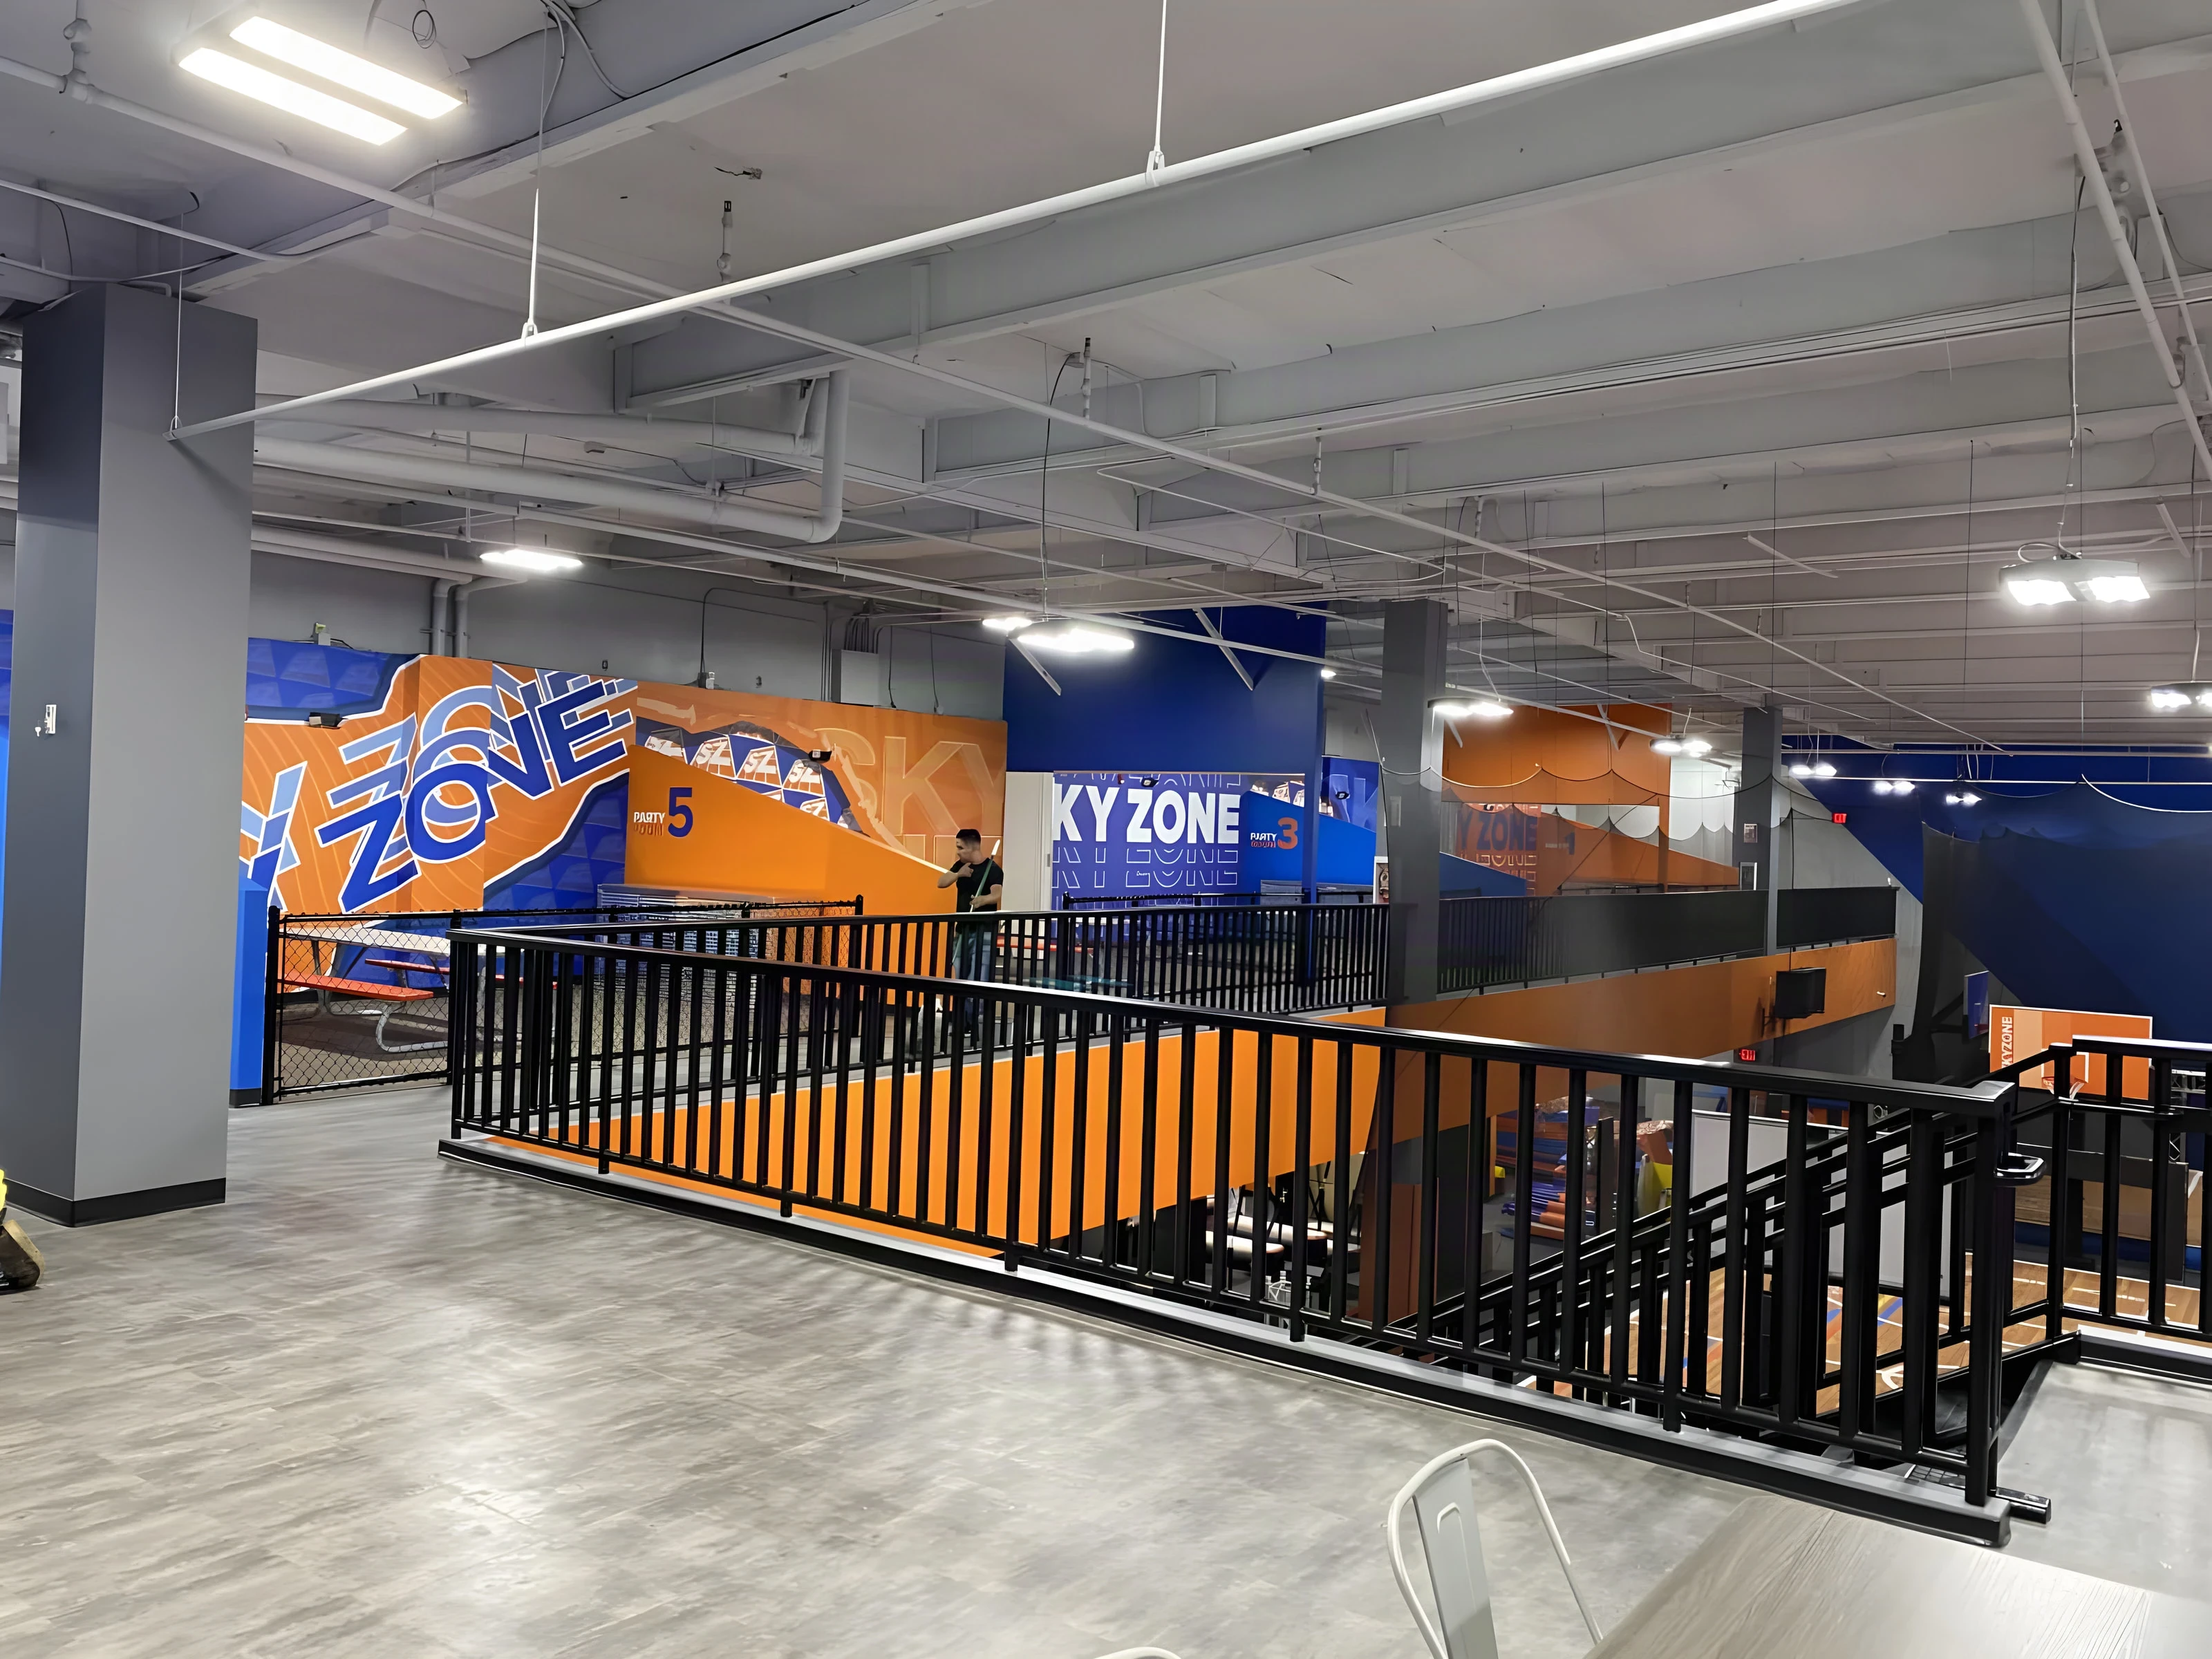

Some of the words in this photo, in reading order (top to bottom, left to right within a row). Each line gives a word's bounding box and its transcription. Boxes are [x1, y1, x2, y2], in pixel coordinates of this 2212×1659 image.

[314, 679, 629, 915] ZONE
[668, 787, 693, 838] 5
[1126, 788, 1241, 844] ZONE
[1277, 817, 1298, 850] 3
[1477, 812, 1538, 851] ZONE
